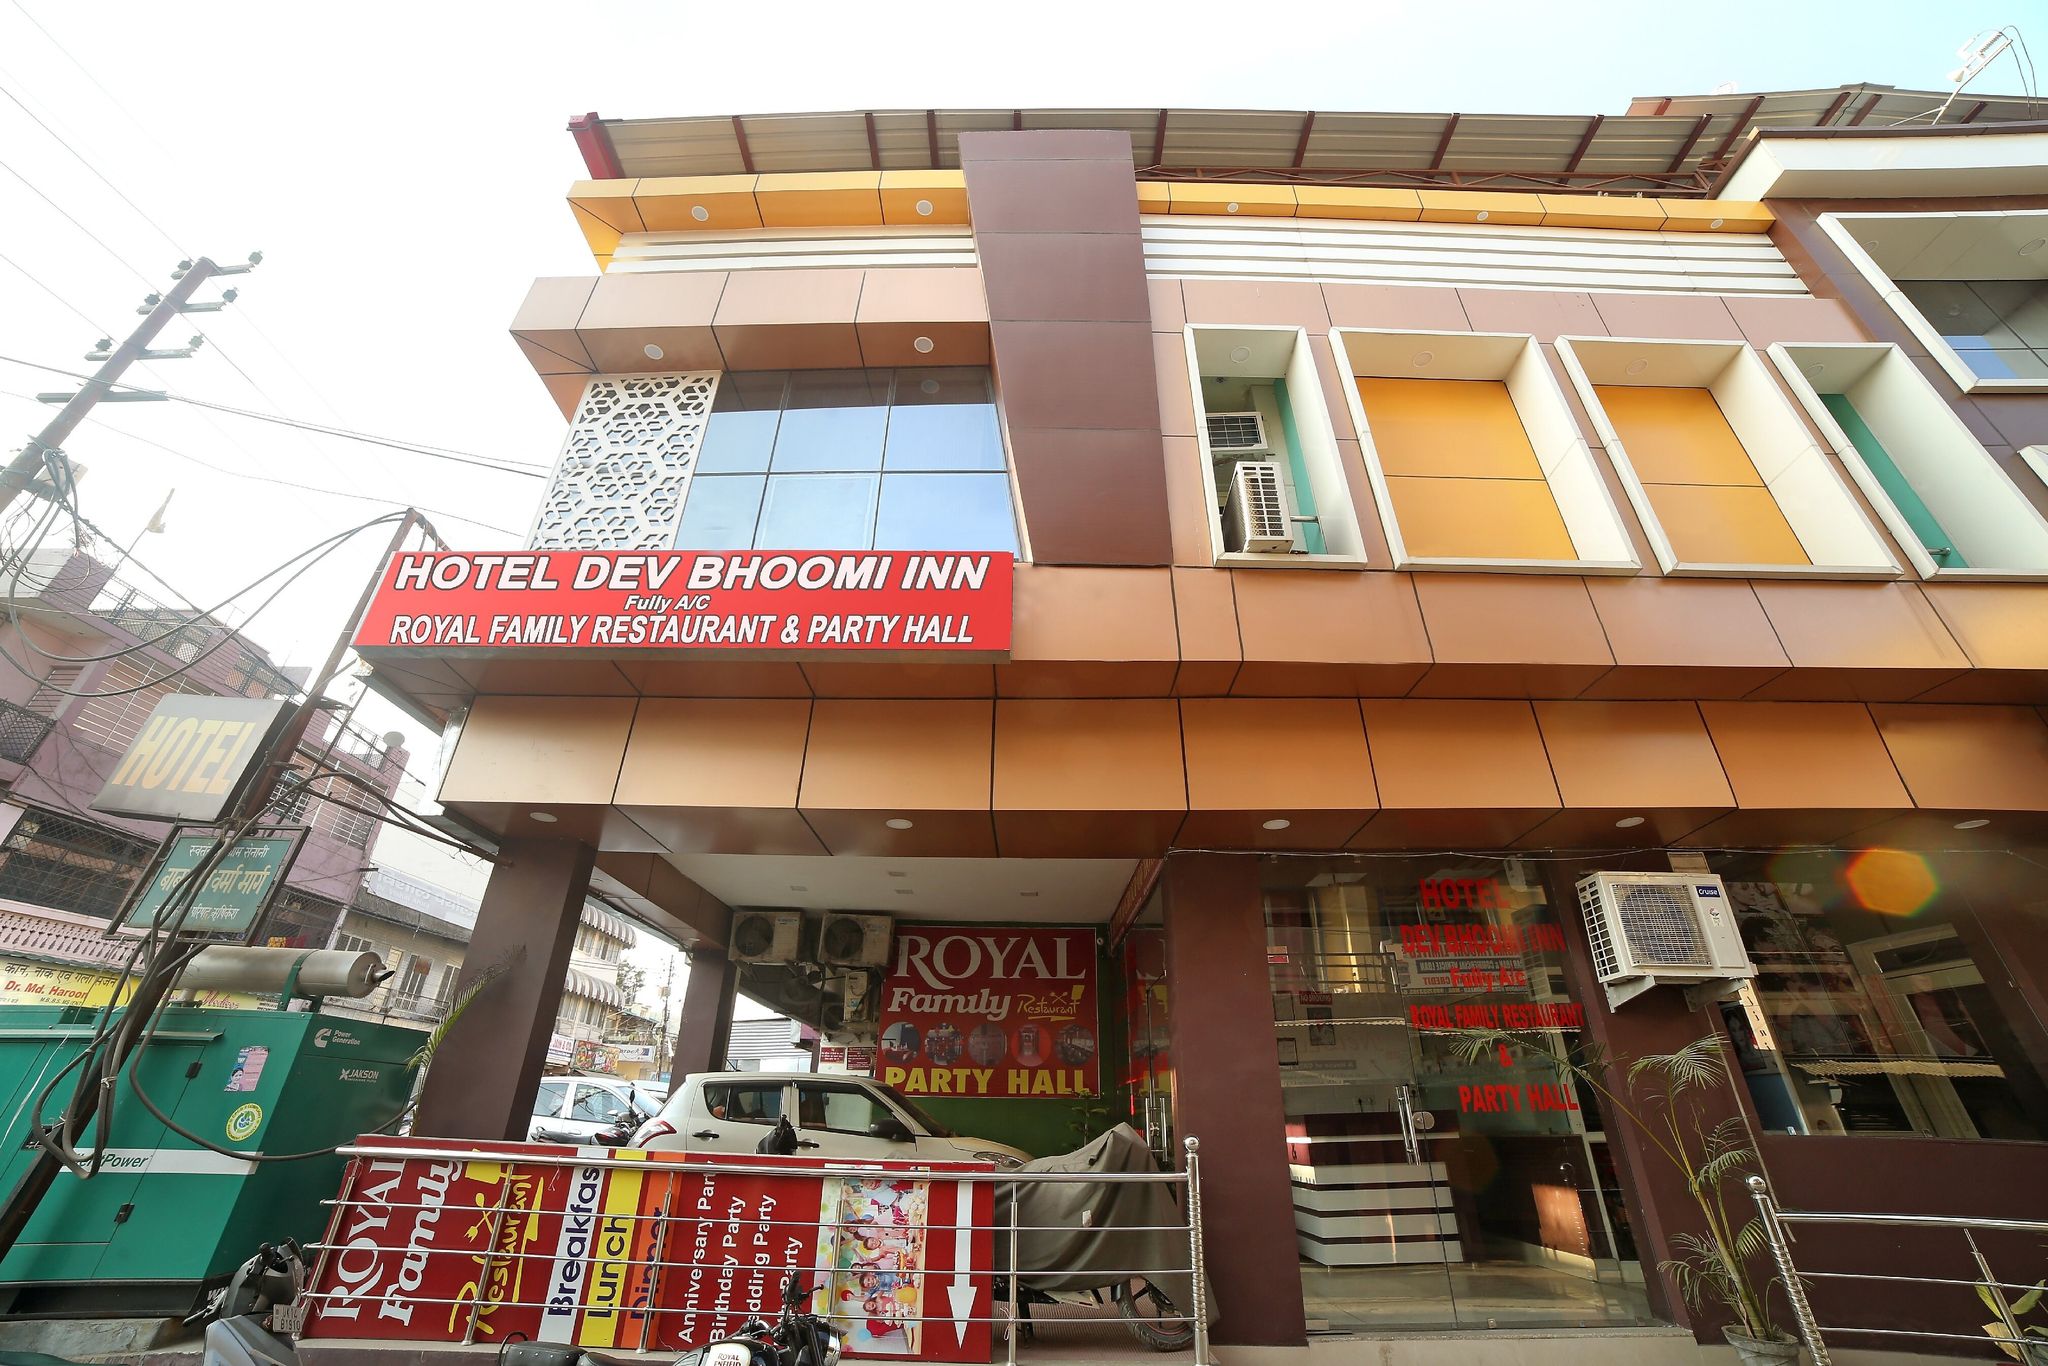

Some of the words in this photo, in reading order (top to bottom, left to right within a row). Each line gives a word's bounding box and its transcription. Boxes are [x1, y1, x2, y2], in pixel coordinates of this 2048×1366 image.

[393, 554, 559, 590] HOTEL
[573, 554, 681, 590] DEV
[687, 554, 892, 590] BHOOMI
[900, 554, 991, 590] INN
[624, 594, 673, 614] Fully
[674, 594, 711, 611] A/C
[389, 614, 481, 644] ROYAL
[487, 614, 590, 644] FAMILY
[590, 614, 776, 644] RESTAURANT
[781, 614, 800, 644] &
[807, 614, 901, 644] PARTY
[902, 614, 974, 644] HALL
[111, 715, 256, 795] HOTEL
[1419, 878, 1511, 910] HOTEL
[1698, 887, 1718, 896] Cruise
[1401, 924, 1442, 953] DEV
[1527, 923, 1567, 952] INN
[893, 935, 1086, 990] ROYAL
[4, 980, 20, 991] Dr.
[25, 982, 45, 995] Md.
[1450, 966, 1494, 993] Fully
[888, 987, 1012, 1021] Family
[1017, 993, 1081, 1014] Restaurant
[1409, 1004, 1453, 1029] ROYAL
[1454, 1004, 1500, 1028] FAMILY
[1503, 1003, 1585, 1027] RESTAURANT
[332, 1034, 361, 1046] Generation
[334, 1029, 352, 1038] Power
[348, 1069, 380, 1080] JAKSON
[885, 1066, 994, 1093] PARTY
[1007, 1069, 1090, 1094] HALL
[1458, 1084, 1521, 1113] PARTY
[1526, 1083, 1579, 1112] HALL
[723, 1196, 746, 1248] Party
[753, 1194, 777, 1246] Party
[548, 1167, 601, 1317] Breakfas
[586, 1213, 630, 1319] Lunch
[678, 1217, 713, 1344] Anniversary
[709, 1254, 739, 1343] Birthday
